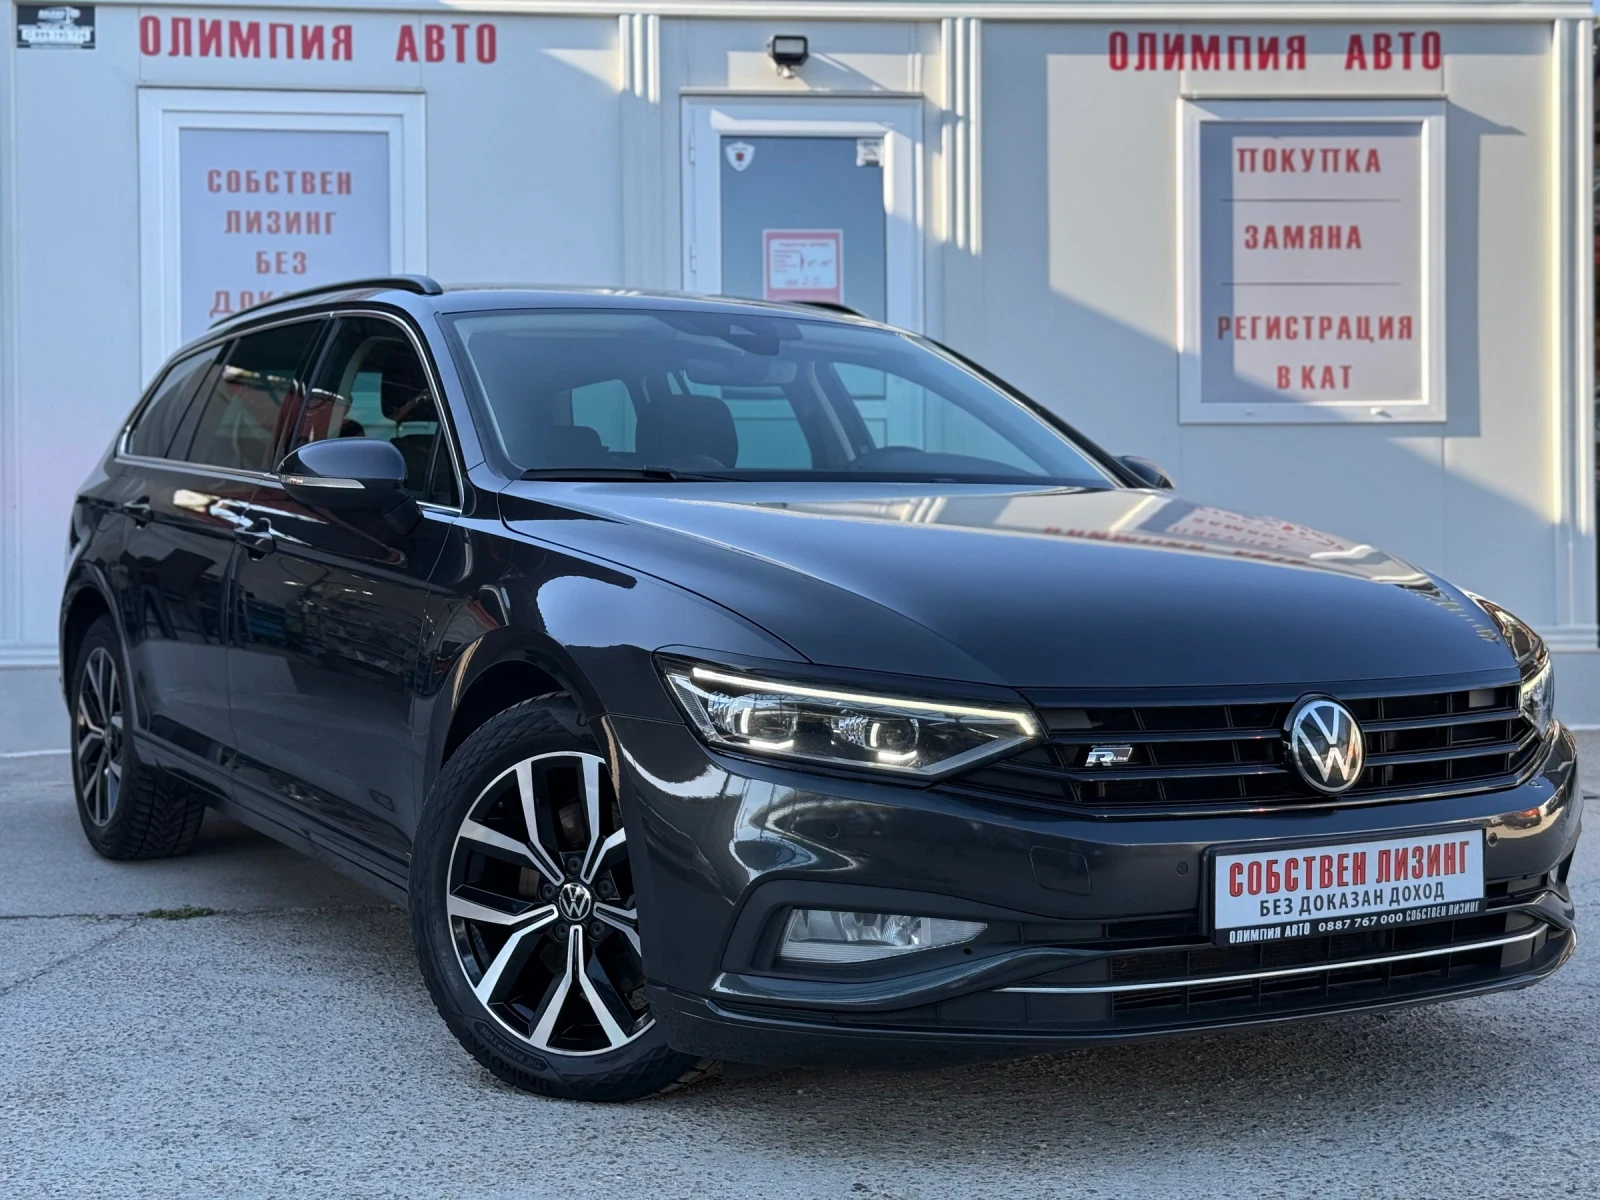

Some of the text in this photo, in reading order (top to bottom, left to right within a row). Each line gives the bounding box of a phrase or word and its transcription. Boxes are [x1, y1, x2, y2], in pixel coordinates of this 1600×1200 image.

[140, 16, 497, 64] ОЛИМПИЯ АВТО
[1108, 31, 1442, 71] ОЛИМПИЯ АВТО
[1237, 148, 1381, 173] ПОКУПКА
[207, 169, 352, 195] СОБСТВЕН
[224, 210, 336, 235] ЛИЗИНГ
[1244, 225, 1361, 250] ЗАМЯНА
[256, 251, 307, 275] БЕЗ
[1218, 316, 1413, 343] РЕГИСТРАЦИЯ
[1277, 365, 1352, 390] В КАТ
[1229, 840, 1470, 898] СОБСТВЕН ЛИЗИНГ
[1259, 881, 1445, 917] БЕЗ ДОКАЗАН ДОХОД
[1229, 900, 1480, 944] ОЛИМПИЯ АВТО 0887 767 000 СОБСТВЕН ЛИЗИНГ
[480, 1024, 500, 1047] TYRE
[502, 1044, 525, 1061] RAIN
